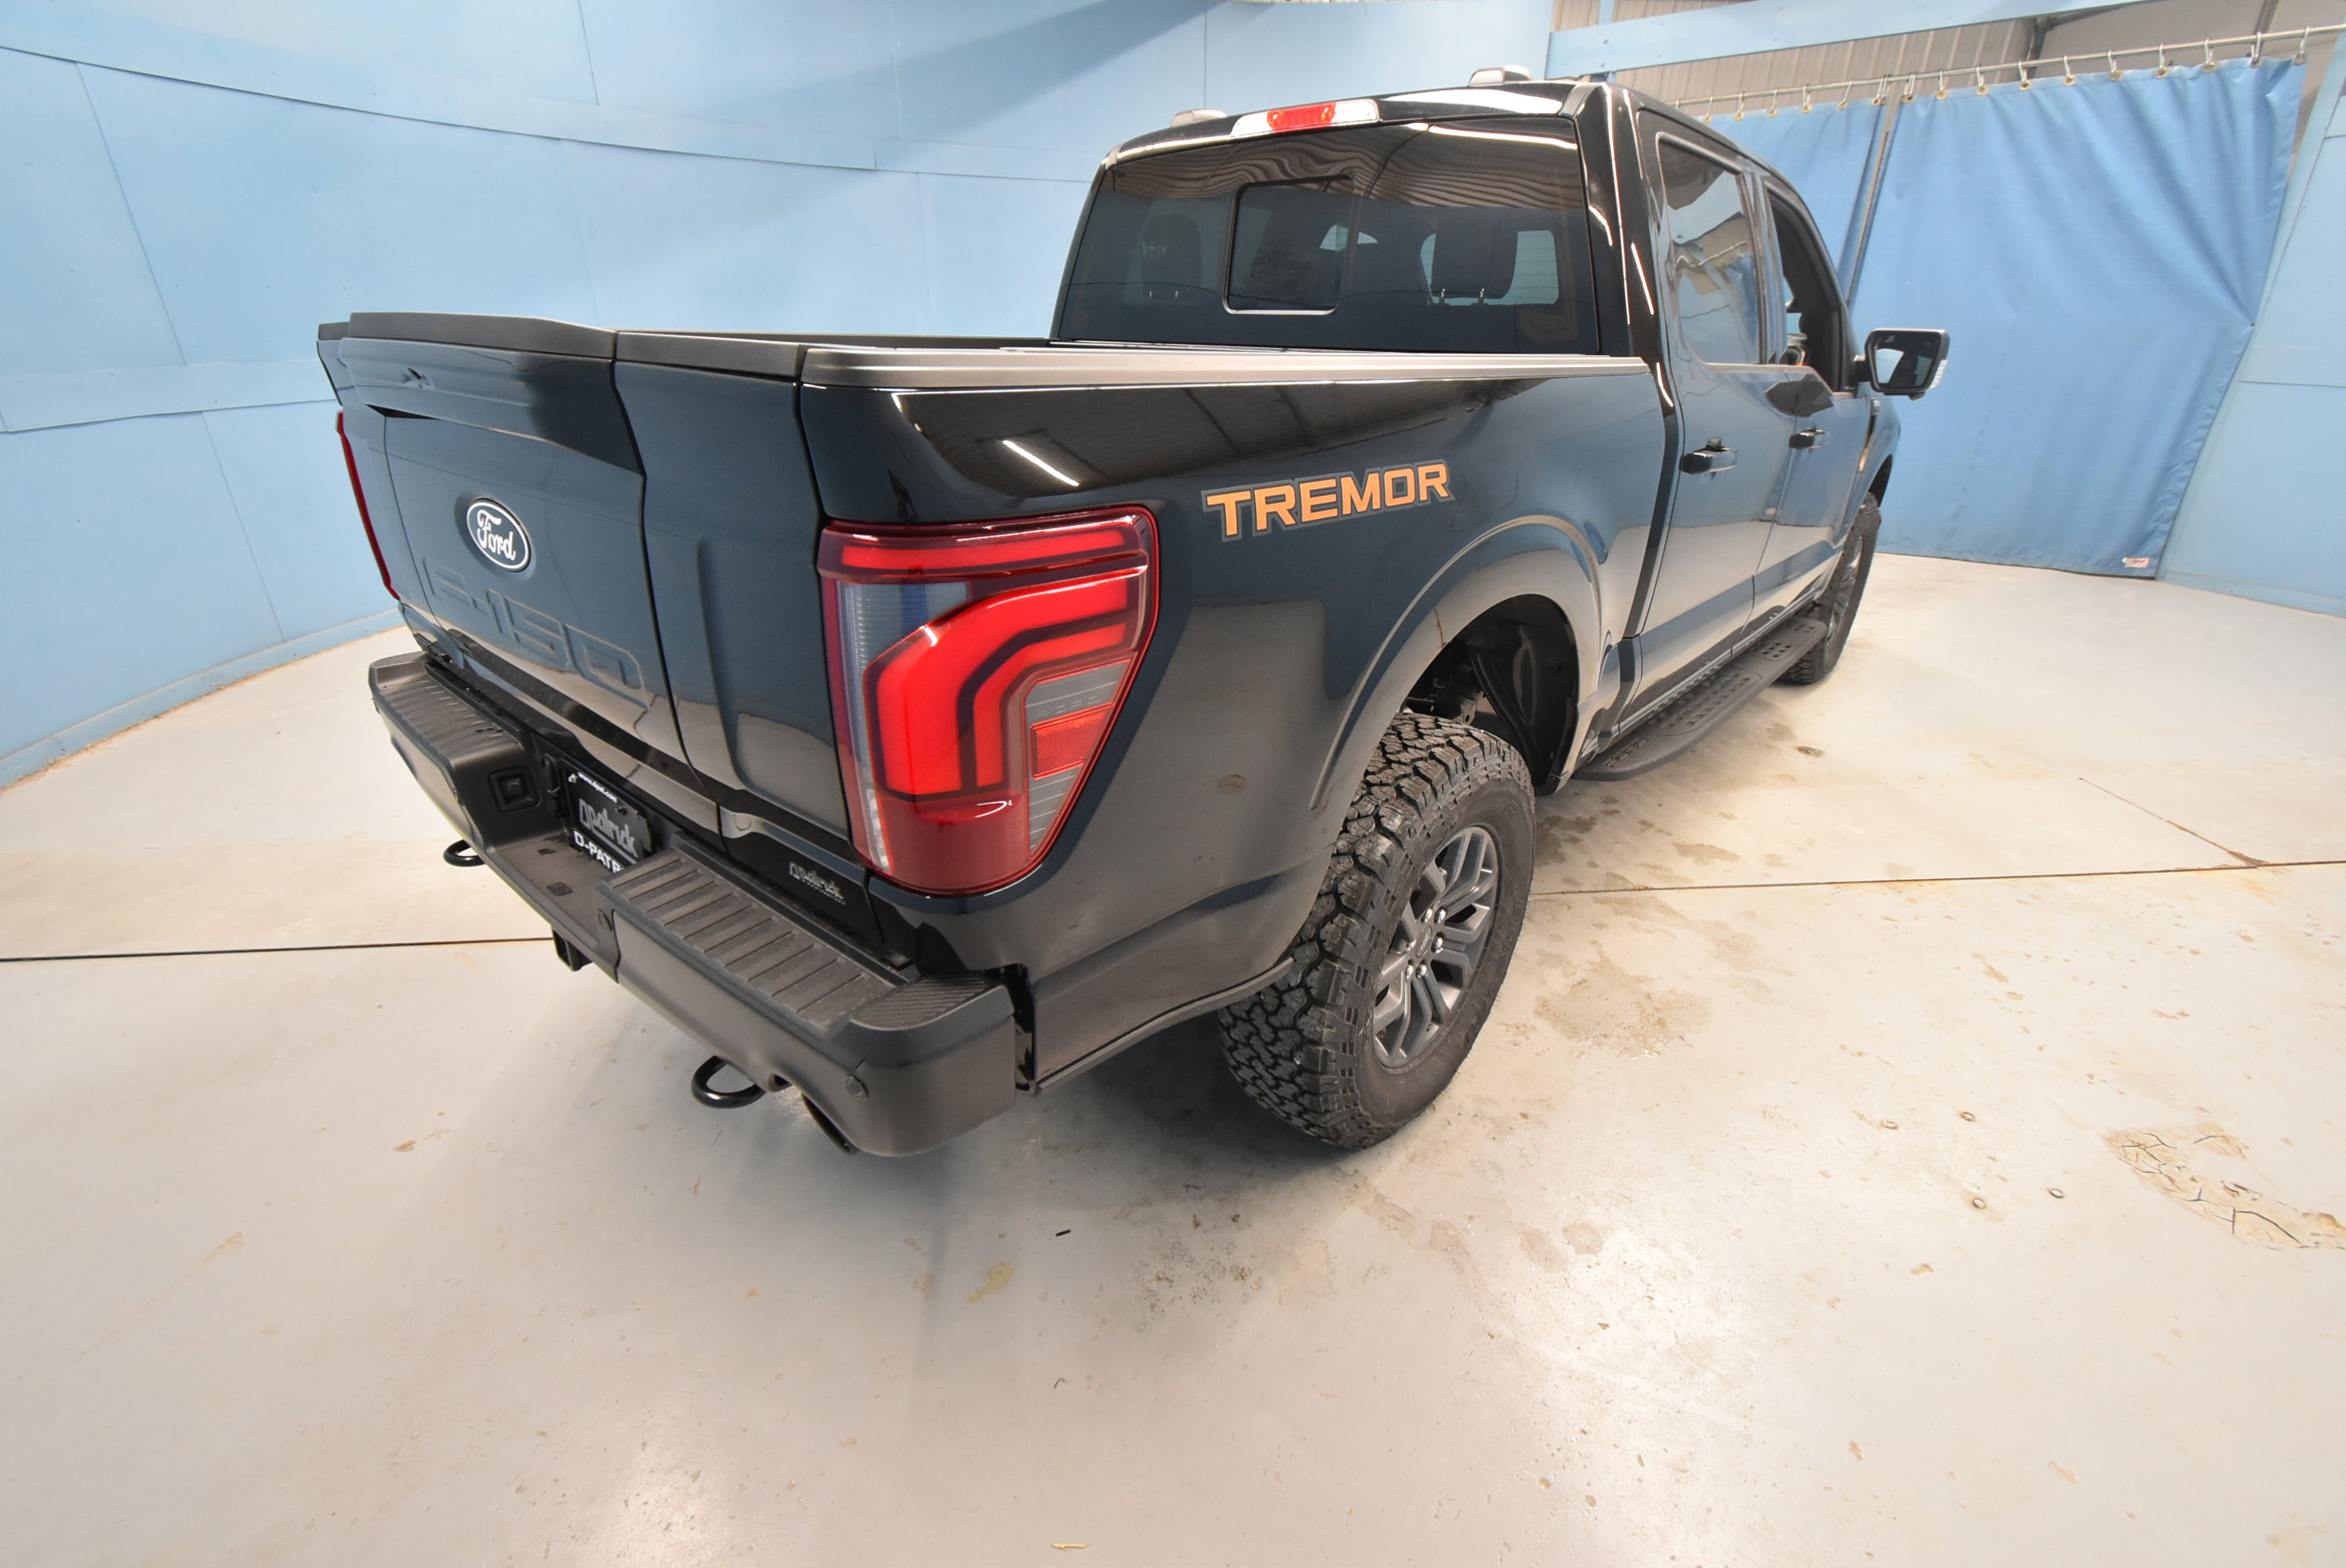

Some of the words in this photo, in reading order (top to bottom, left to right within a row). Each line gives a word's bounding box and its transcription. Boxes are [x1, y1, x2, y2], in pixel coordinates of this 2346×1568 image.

[1201, 459, 1454, 542] TREMOR
[476, 509, 517, 561] Ford
[422, 557, 649, 710] F-150
[573, 830, 624, 873] D-PATR
